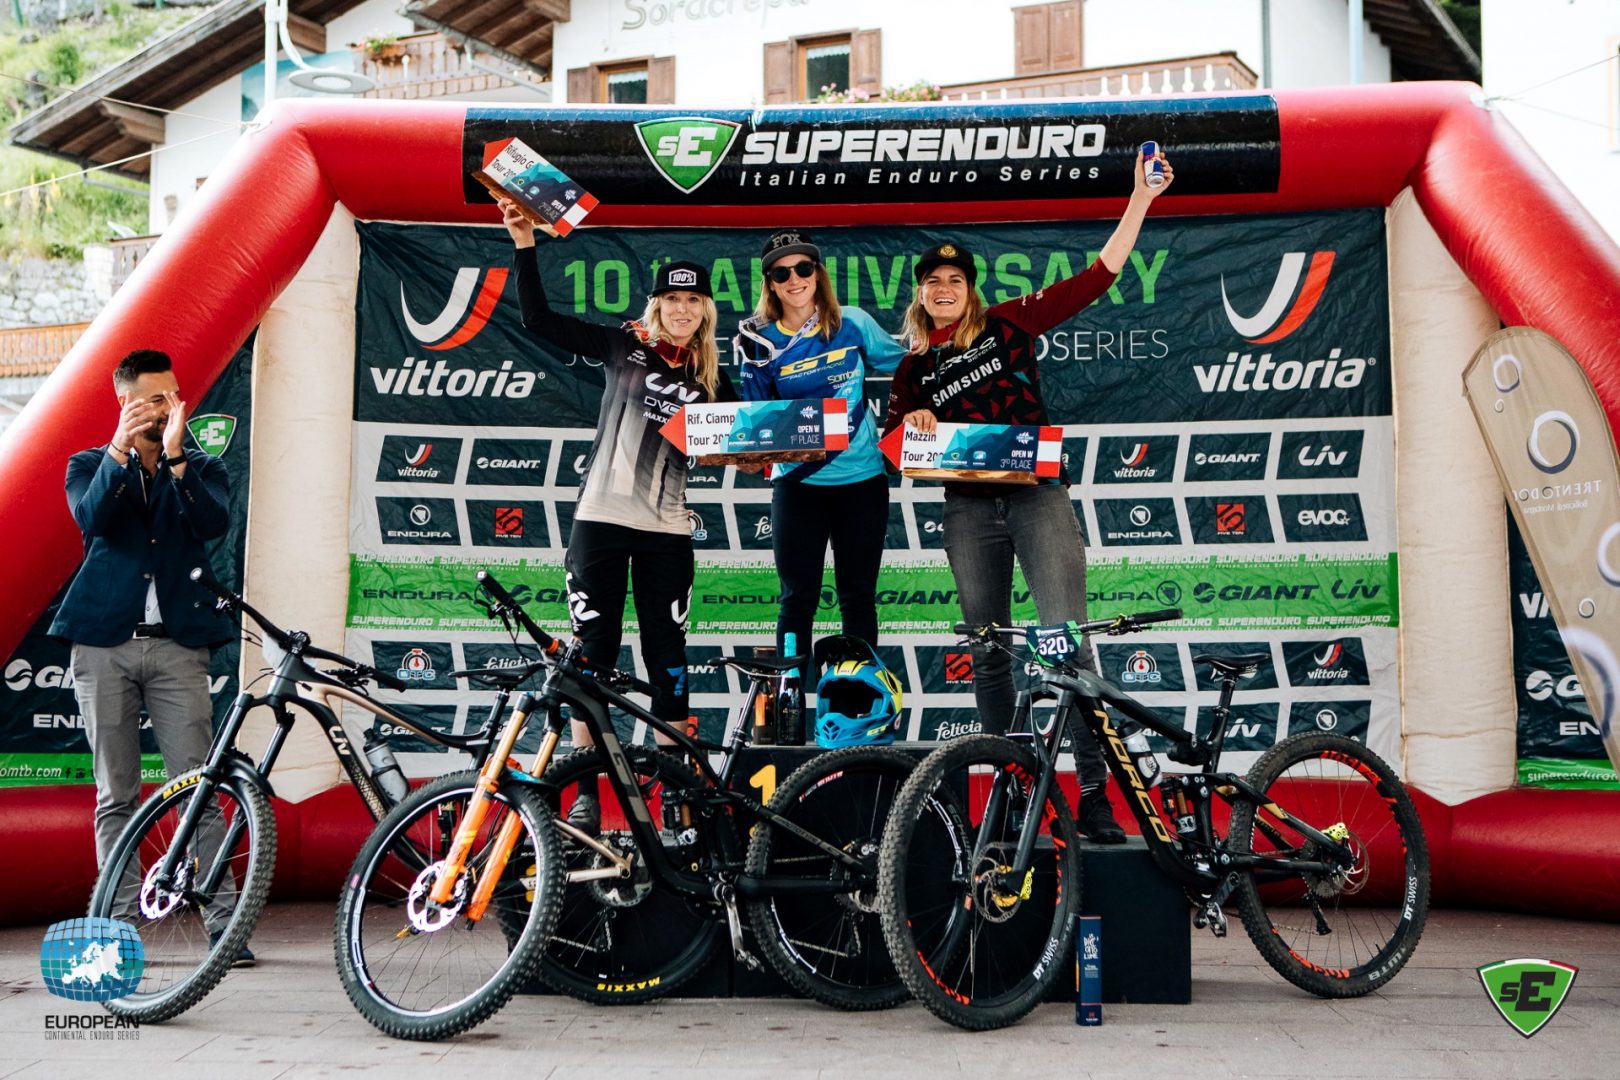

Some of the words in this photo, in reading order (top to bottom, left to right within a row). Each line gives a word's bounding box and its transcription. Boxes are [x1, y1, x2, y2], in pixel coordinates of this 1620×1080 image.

[621, 0, 808, 30] Soracrep
[741, 124, 1106, 165] SUPERENDURO
[504, 144, 527, 165] Rifugio
[491, 158, 505, 172] Tour
[740, 170, 846, 186] Italian
[868, 168, 978, 184] Enduro
[999, 164, 1100, 182] Series
[772, 233, 802, 249] FOX
[564, 259, 630, 314] 10
[711, 249, 1169, 312] AIVRSARY
[672, 272, 693, 283] 100%
[932, 357, 1003, 407] SAMSUNG
[643, 411, 668, 424] MAXX
[687, 413, 703, 425] Rif.
[705, 412, 735, 426] Ciamp
[797, 425, 813, 433] OPEN
[688, 435, 710, 446] Tour
[799, 434, 821, 444] PLACE
[905, 431, 937, 442] Mazzin
[903, 451, 924, 462] Tour
[1011, 449, 1026, 458] OPEN
[1208, 453, 1260, 463] GIANT
[1298, 445, 1347, 466] Liv
[490, 459, 541, 469] GIANT
[1011, 458, 1032, 469] PLACE
[397, 468, 439, 478] vittoria
[1113, 467, 1156, 478] vittoria
[387, 530, 452, 539] ENDURA
[1108, 531, 1173, 539] ENDURA
[880, 559, 950, 569] PERENDURO
[1218, 584, 1320, 601] GIANT
[1331, 578, 1382, 599] Liv
[363, 589, 474, 601] ENDURA
[702, 594, 781, 604] ENDU
[1087, 591, 1155, 601] DURA
[352, 615, 434, 626] SUPERENDURO
[696, 621, 778, 630] SUPERENDURO
[877, 621, 950, 630] UPERENDURO
[1152, 617, 1213, 627] ERENDURO
[1306, 615, 1391, 625] SUPERENDURO
[1038, 636, 1069, 655] 520
[687, 665, 718, 674] ANT
[1307, 667, 1349, 679] vittoria
[934, 720, 983, 741] felicia
[1224, 718, 1262, 738] iv
[1093, 709, 1173, 843] NORCO
[162, 775, 203, 800] MAXXI
[750, 764, 776, 807] 1
[1407, 876, 1418, 904] SWISS
[1403, 904, 1414, 921] DT
[1032, 962, 1045, 980] DT
[1041, 936, 1059, 966] SWISS
[597, 976, 660, 993] MAXXIS
